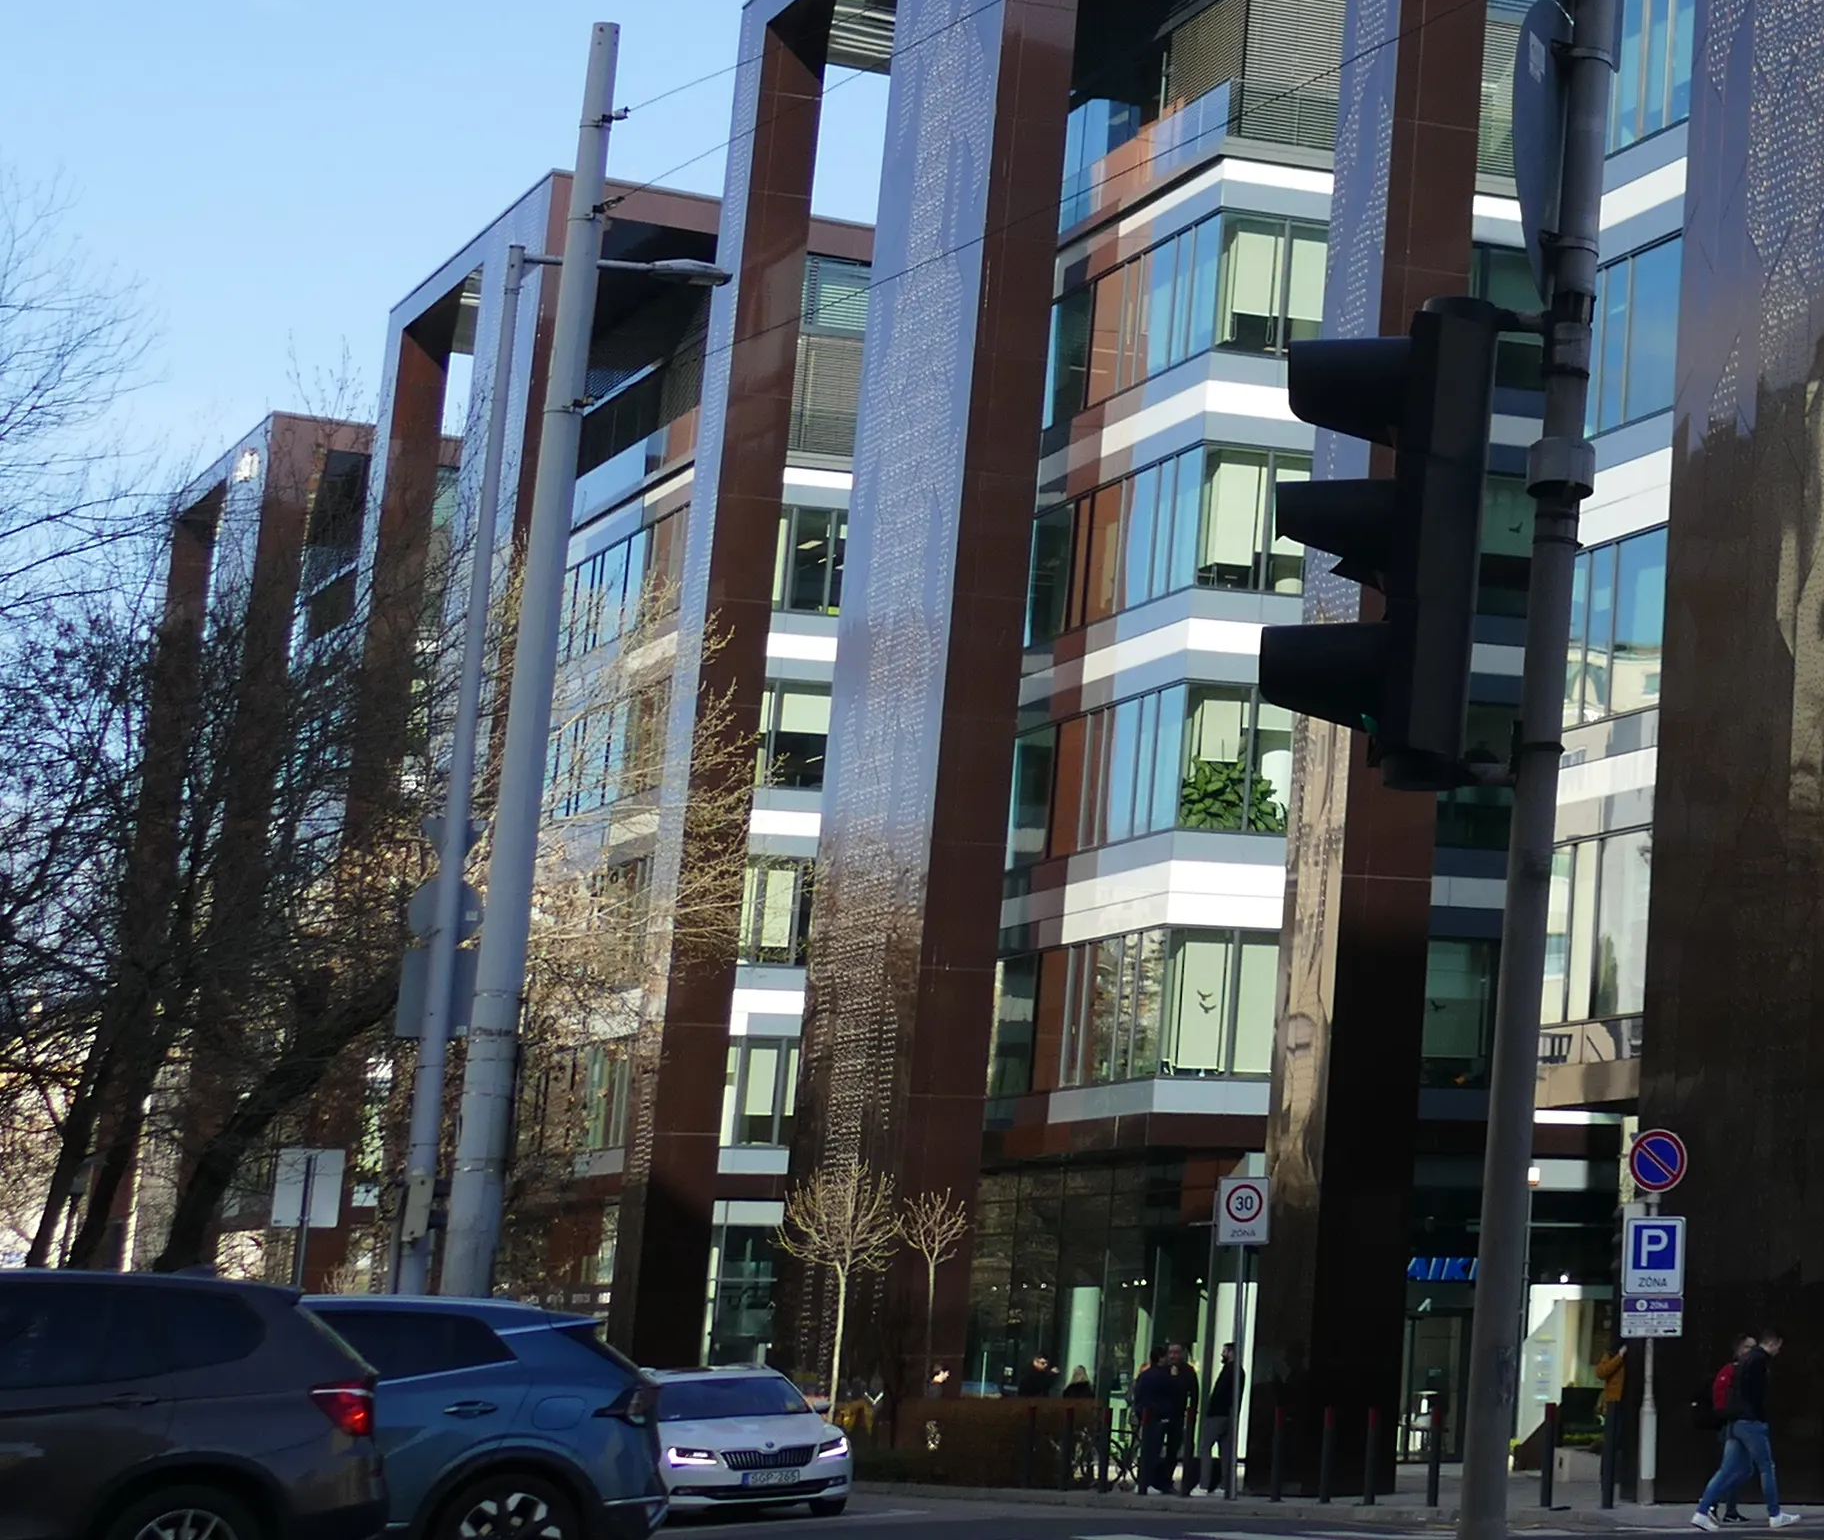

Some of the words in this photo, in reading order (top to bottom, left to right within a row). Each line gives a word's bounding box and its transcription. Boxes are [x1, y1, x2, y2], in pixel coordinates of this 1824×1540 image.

[1235, 1195, 1254, 1212] 30
[1229, 1227, 1257, 1238] ZÓNA
[1640, 1228, 1669, 1267] P
[1638, 1276, 1668, 1288] ZÓNA
